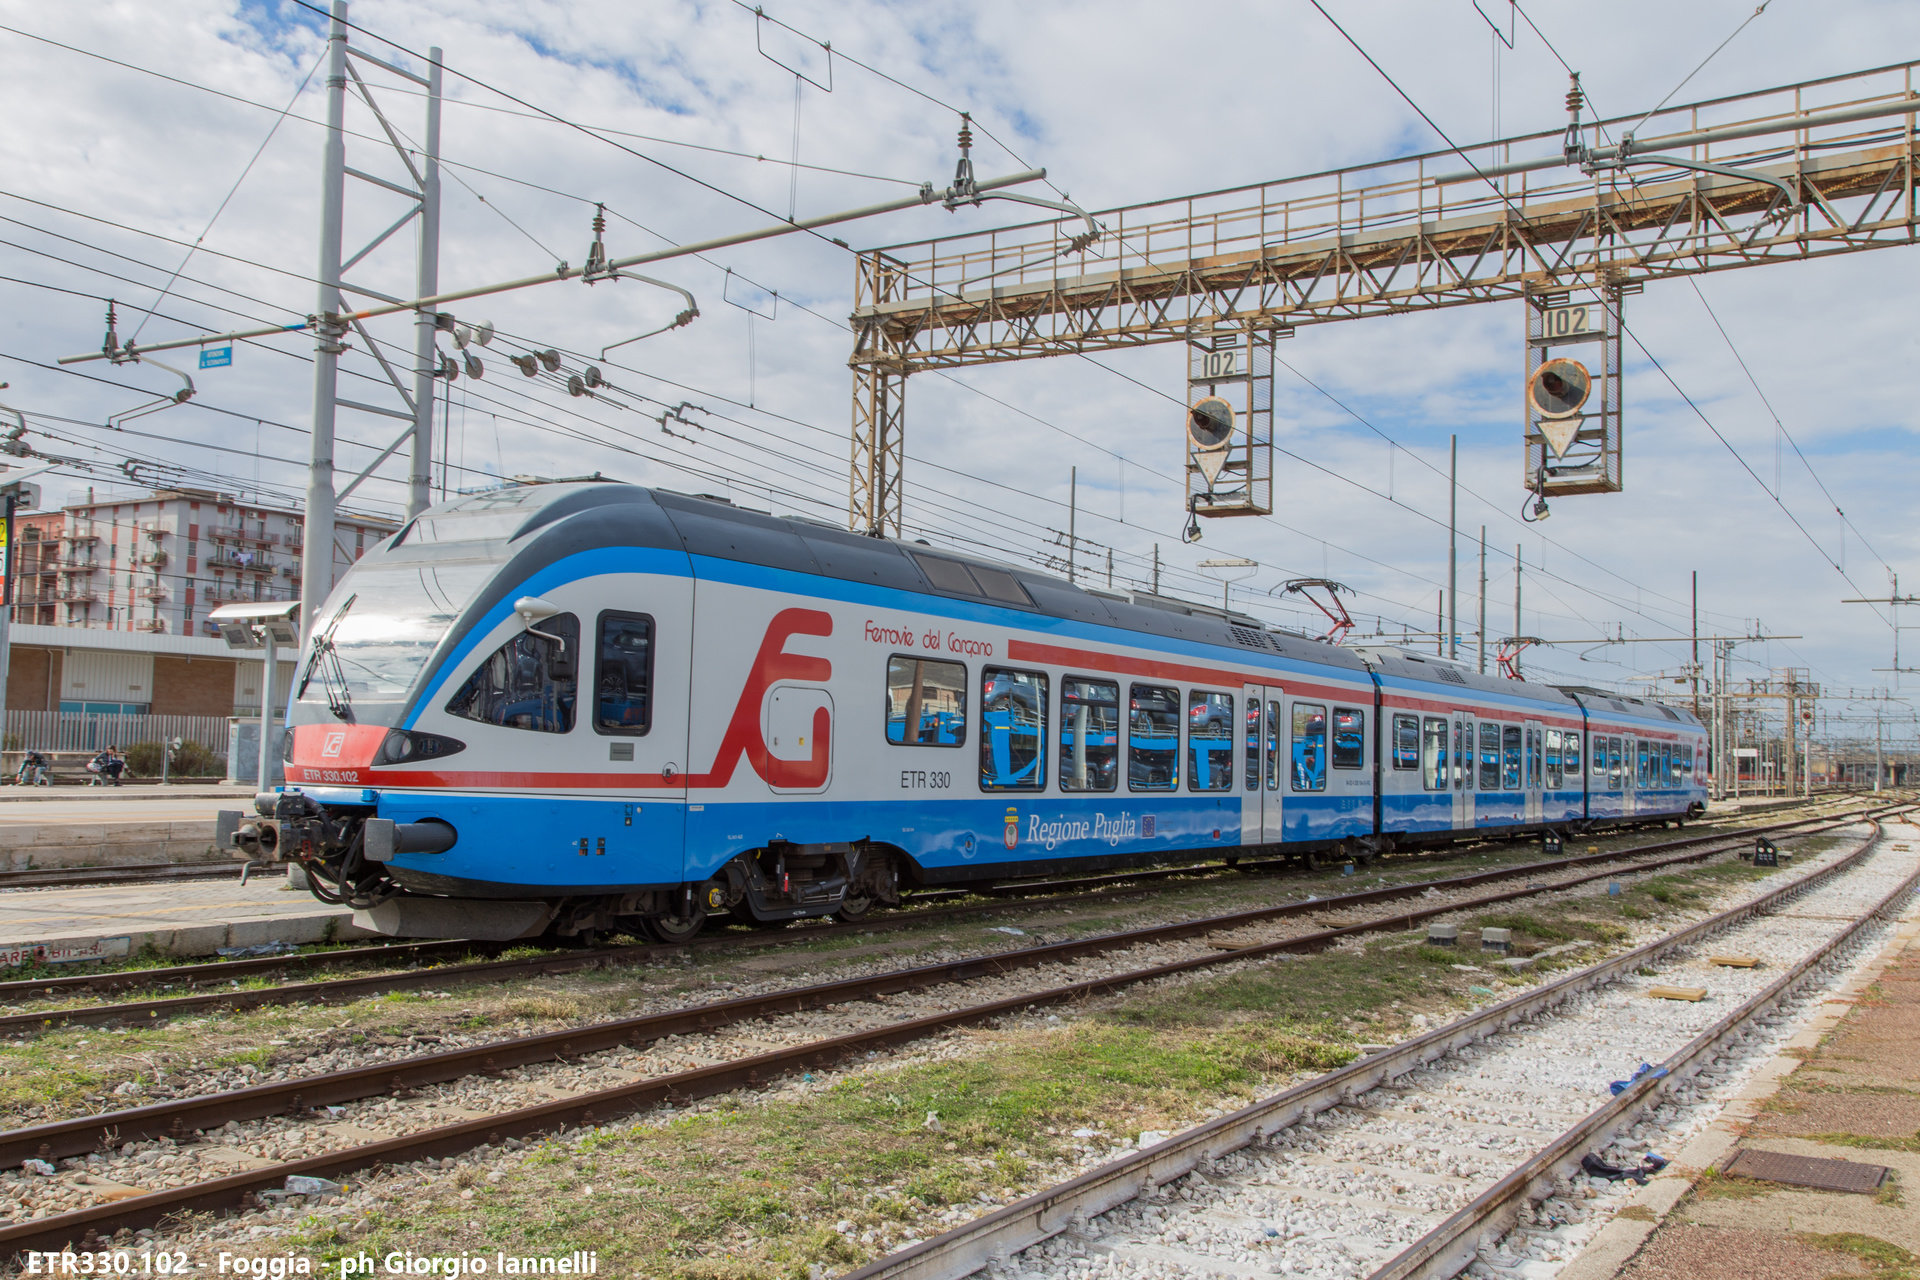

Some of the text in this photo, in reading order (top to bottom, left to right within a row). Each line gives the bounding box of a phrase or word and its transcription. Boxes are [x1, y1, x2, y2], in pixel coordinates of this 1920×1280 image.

[1547, 306, 1587, 338] 102
[1203, 351, 1234, 378] 102
[864, 619, 993, 658] Ferrovie del Gargano
[303, 768, 359, 783] ETR 330.102
[901, 770, 951, 789] ETR 330
[1026, 811, 1136, 851] Regione Puglia
